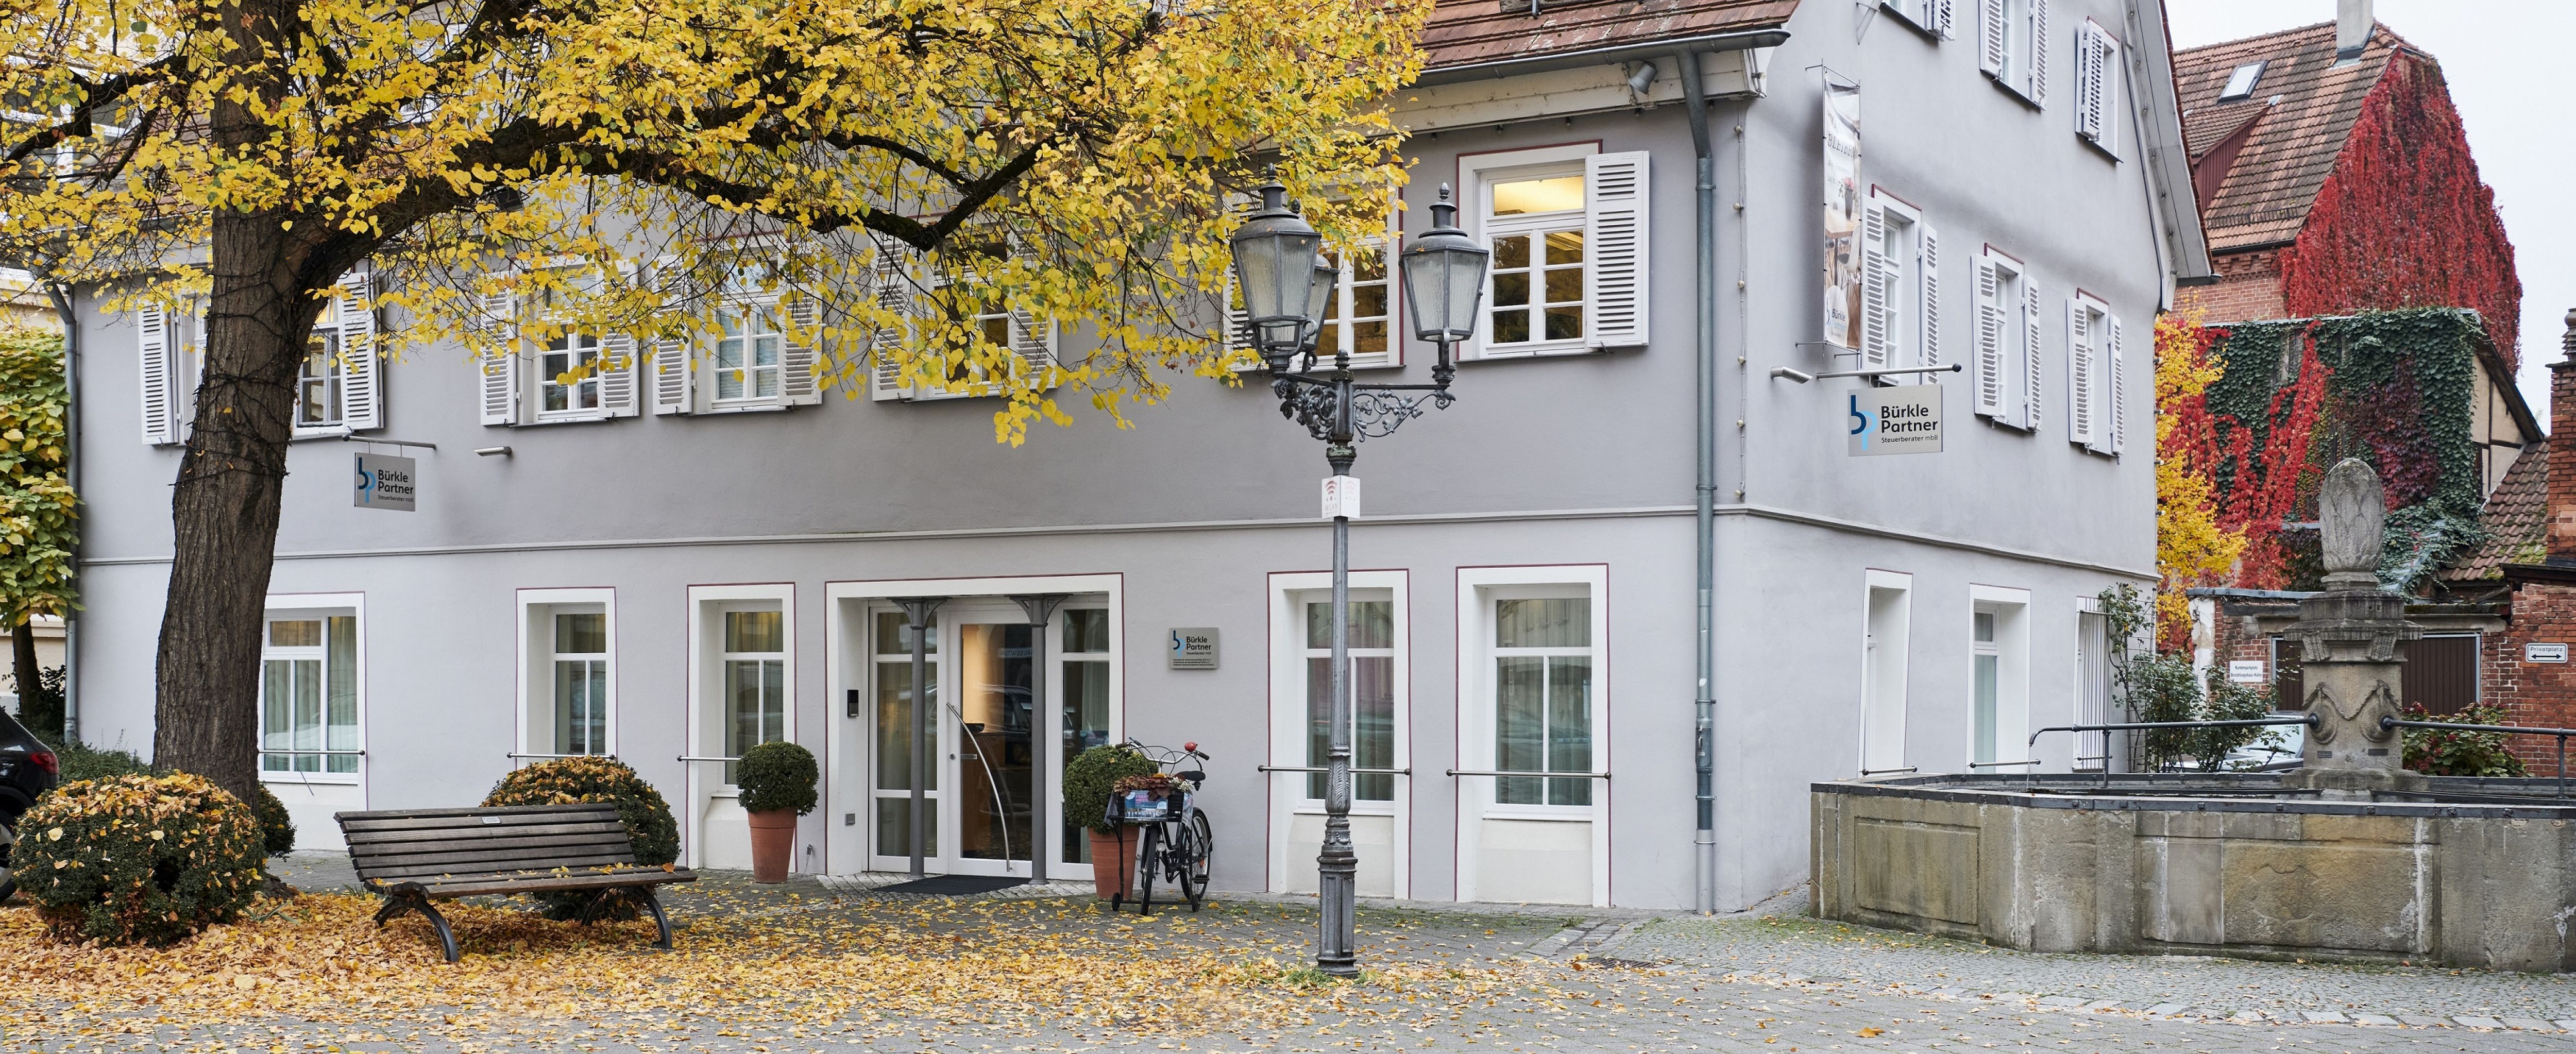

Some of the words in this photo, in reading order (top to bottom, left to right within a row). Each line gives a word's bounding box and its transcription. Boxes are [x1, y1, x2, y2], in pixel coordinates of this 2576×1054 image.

[1881, 404, 1929, 419] Bürkle
[1881, 420, 1938, 433] Partner
[378, 469, 408, 482] Bürkle
[378, 481, 414, 494] Partner
